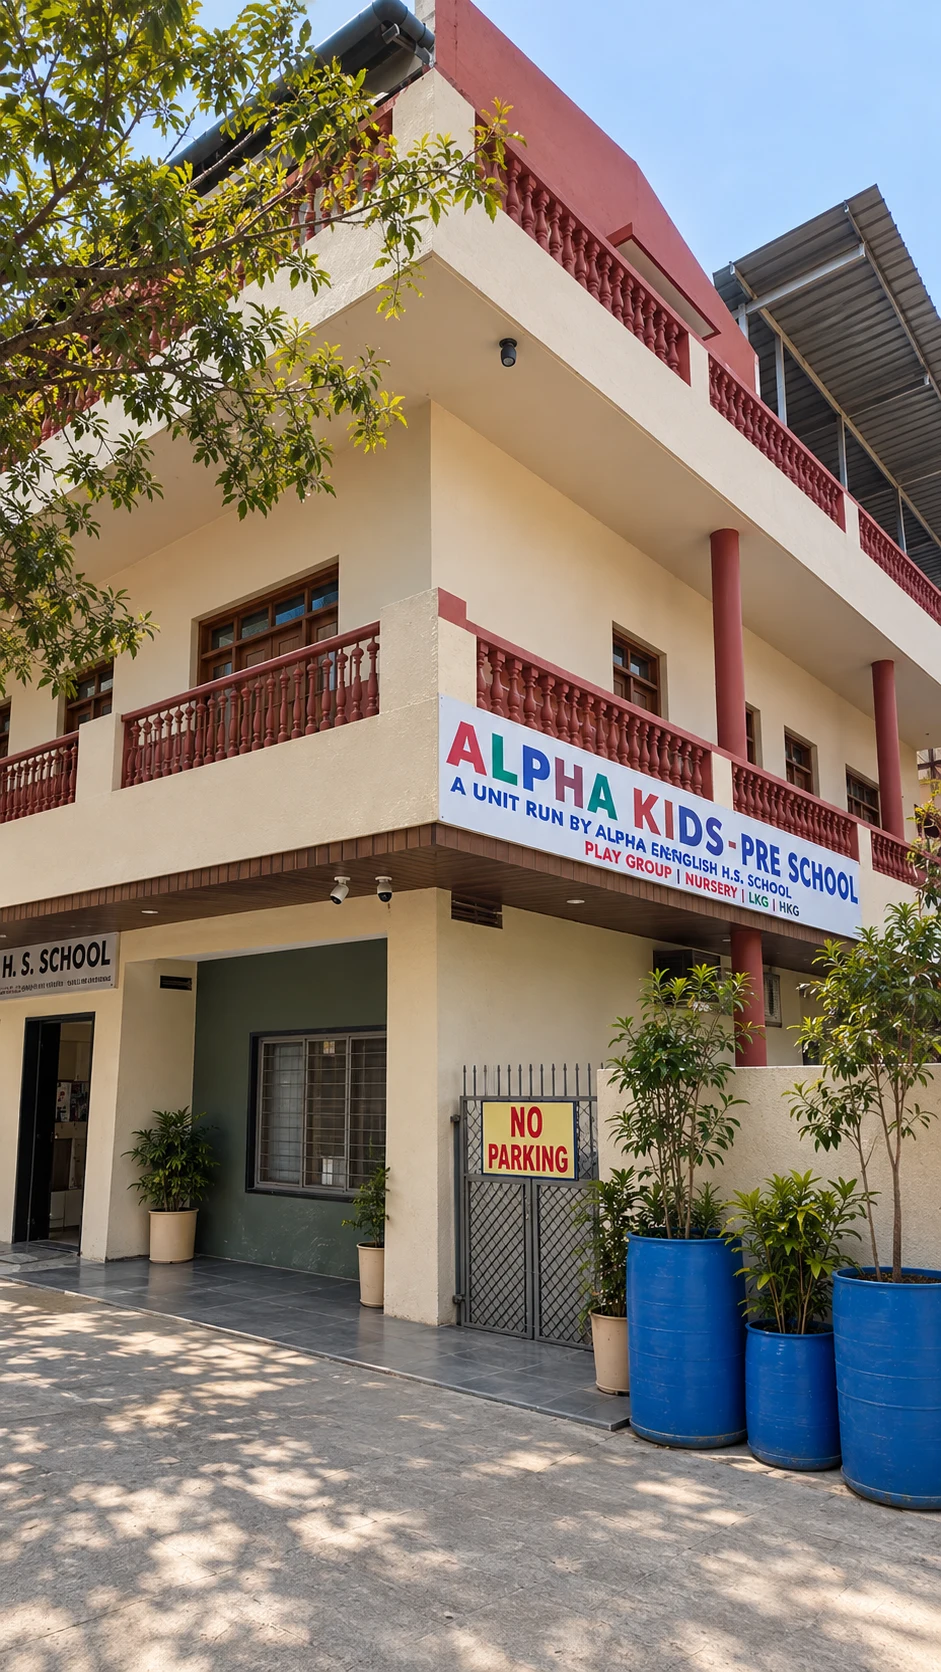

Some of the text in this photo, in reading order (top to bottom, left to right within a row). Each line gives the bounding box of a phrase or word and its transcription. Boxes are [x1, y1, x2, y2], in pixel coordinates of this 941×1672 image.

[446, 721, 618, 821] ALPHA
[788, 852, 858, 904] SCHOOL
[450, 776, 467, 795] A
[473, 782, 520, 812] UNIT
[526, 800, 564, 827] RUN
[570, 814, 592, 834] BY
[595, 824, 647, 853] ALPHA
[721, 865, 744, 885] H.S.
[748, 873, 792, 899] SCHOOL
[585, 840, 800, 917] PLAY GROUP NURSERY LKG HKG
[2, 940, 111, 978] H. S. SCHOOL
[510, 1106, 543, 1139] NO
[488, 1143, 569, 1174] PARKING
